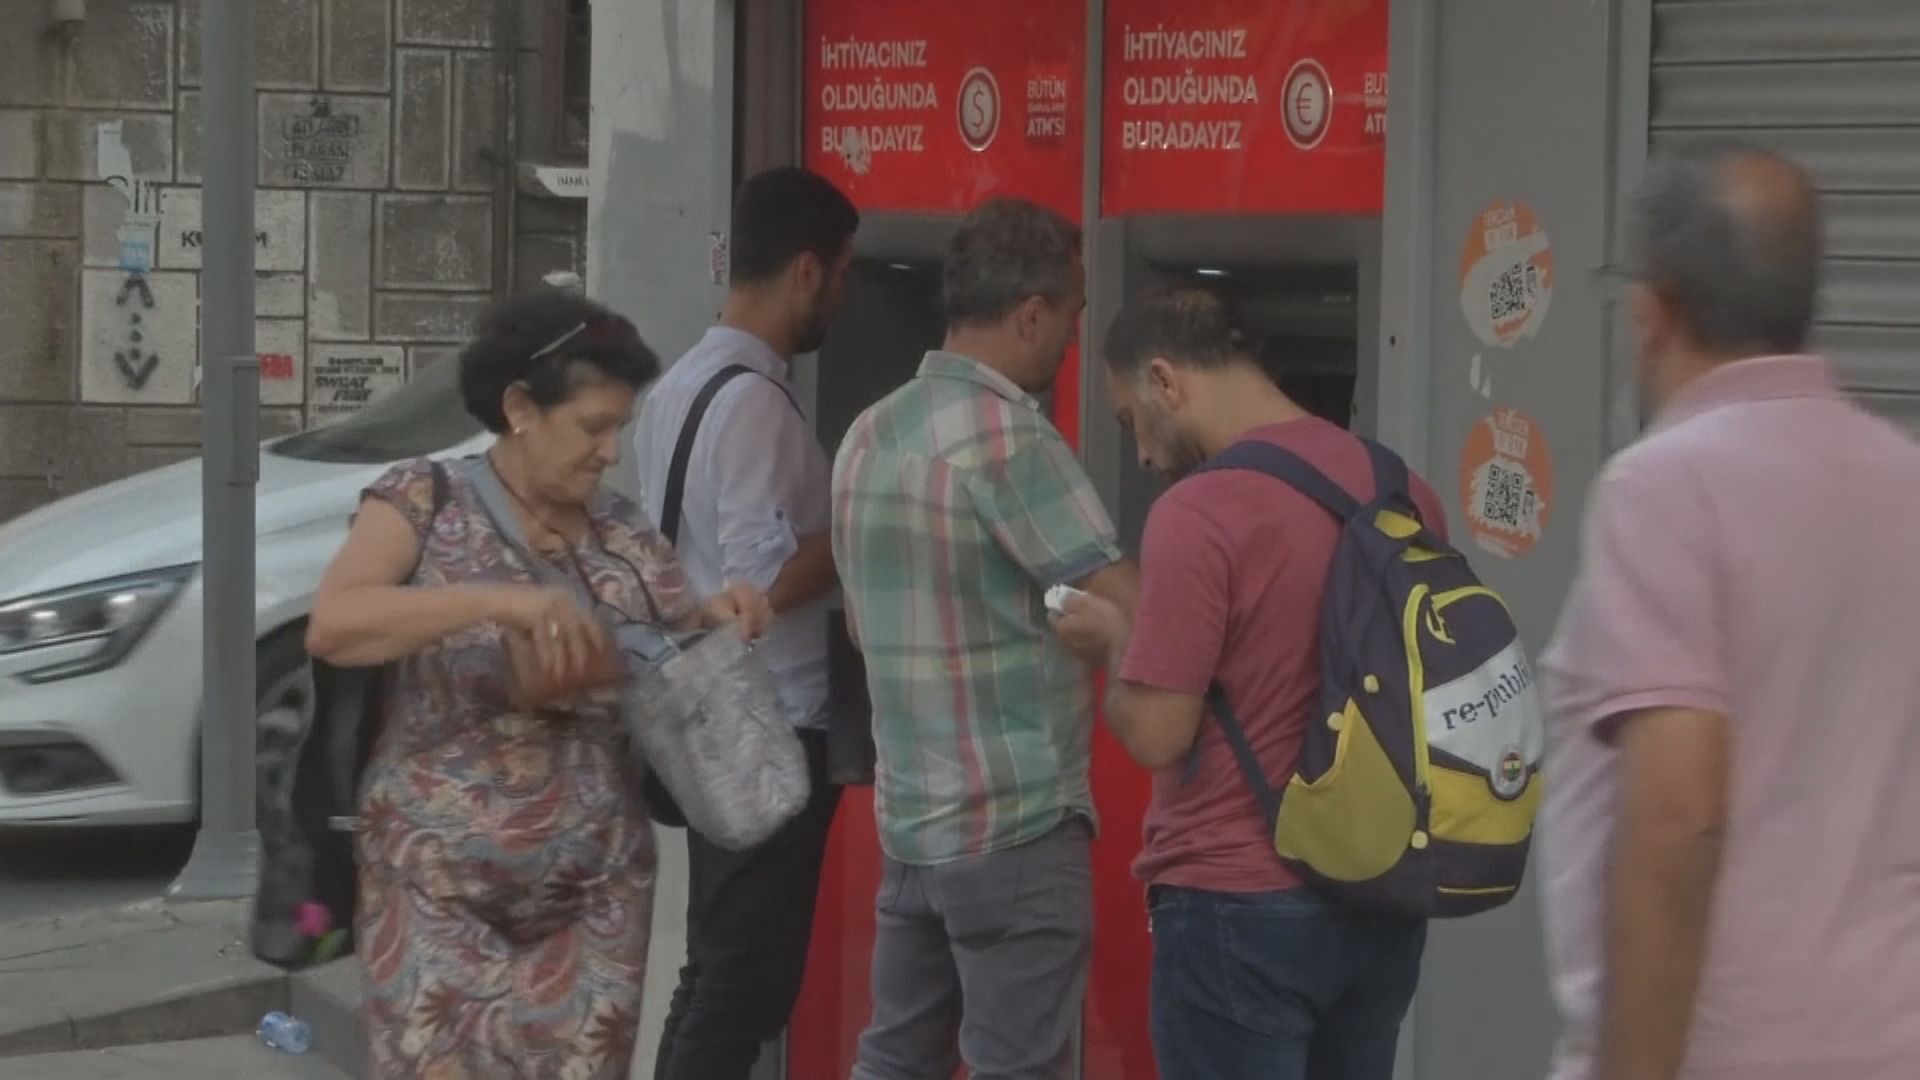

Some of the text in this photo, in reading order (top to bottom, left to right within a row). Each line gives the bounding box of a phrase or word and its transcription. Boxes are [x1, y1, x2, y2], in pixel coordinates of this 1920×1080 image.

[821, 34, 928, 69] İHTİYACINIZ
[1123, 24, 1247, 61] İHTİYACINIZ
[821, 76, 938, 112] OLDUĞUNDA
[1123, 67, 1259, 106] OLDUĞUNDA
[1122, 120, 1243, 150] BURADAYIZ
